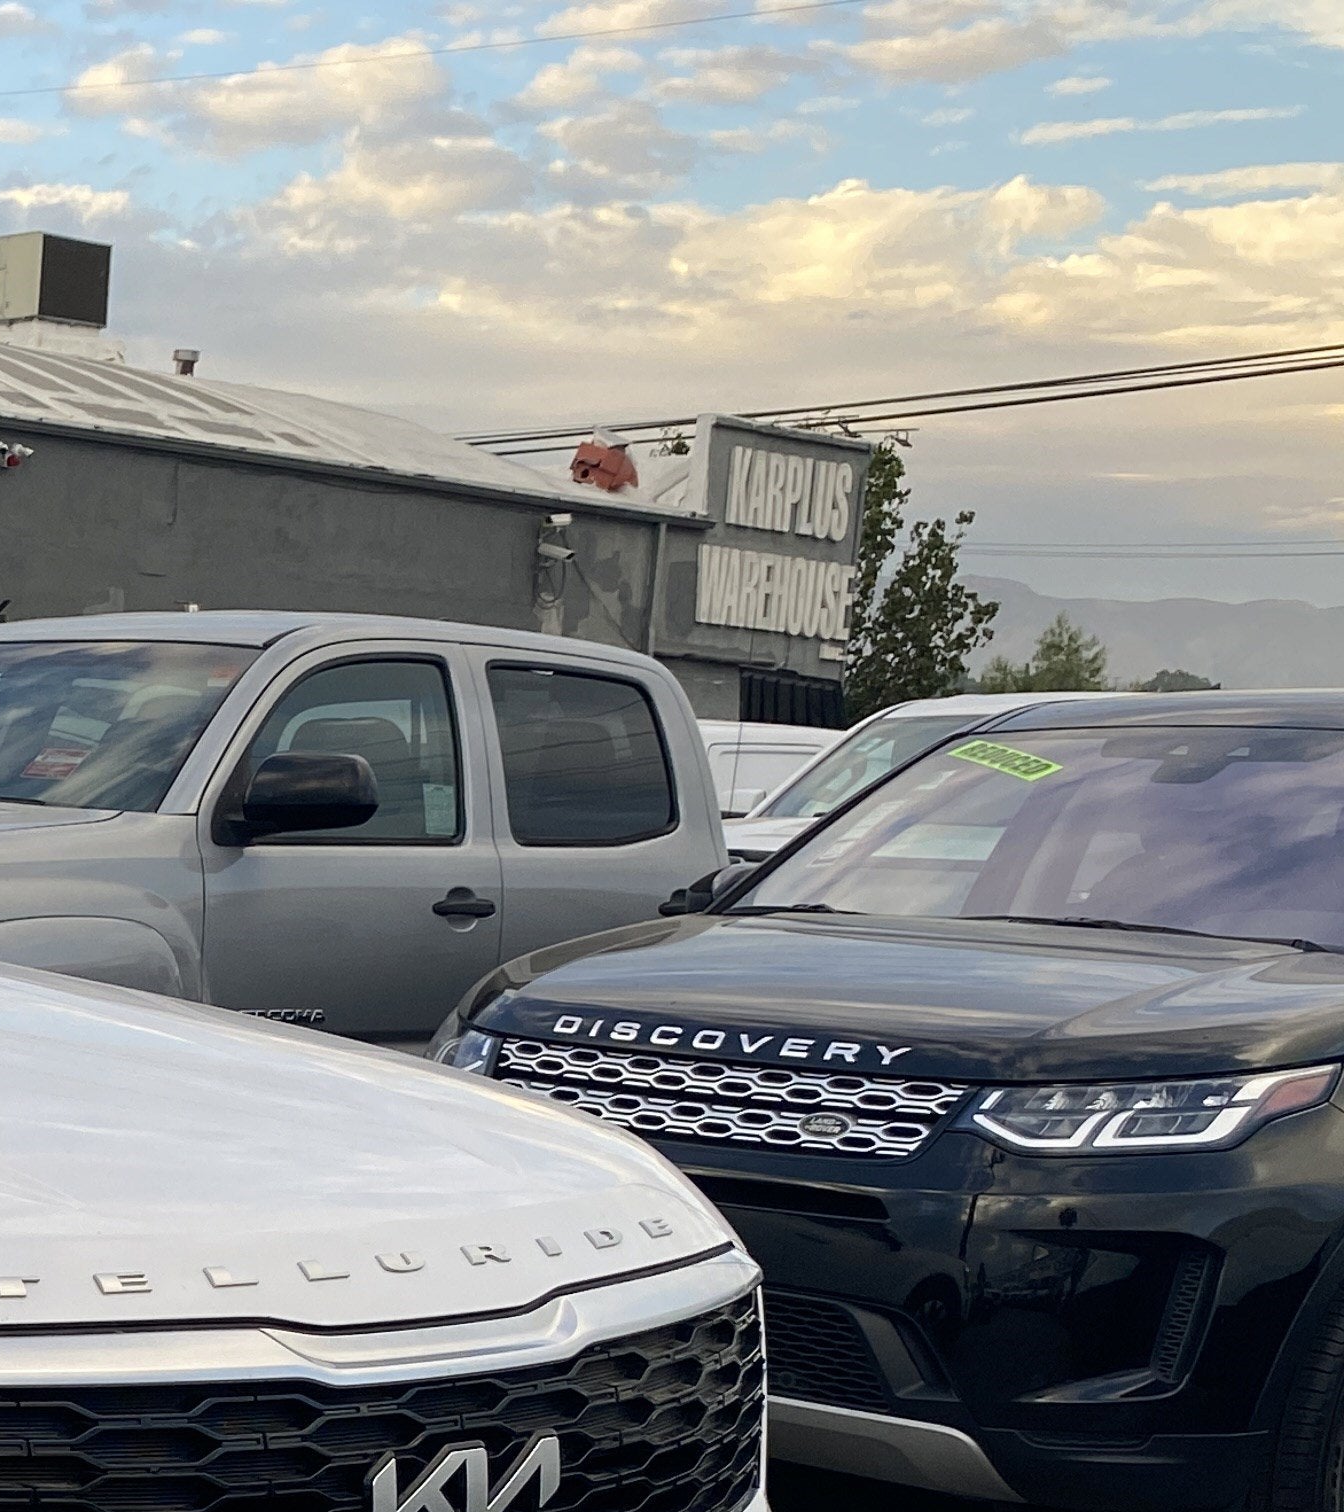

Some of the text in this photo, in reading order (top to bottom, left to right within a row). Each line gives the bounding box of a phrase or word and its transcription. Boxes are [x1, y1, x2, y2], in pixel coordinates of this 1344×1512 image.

[725, 445, 853, 542] KARPLUS
[695, 543, 855, 641] WAREHOUSE
[552, 1014, 912, 1066] DISCOVERY
